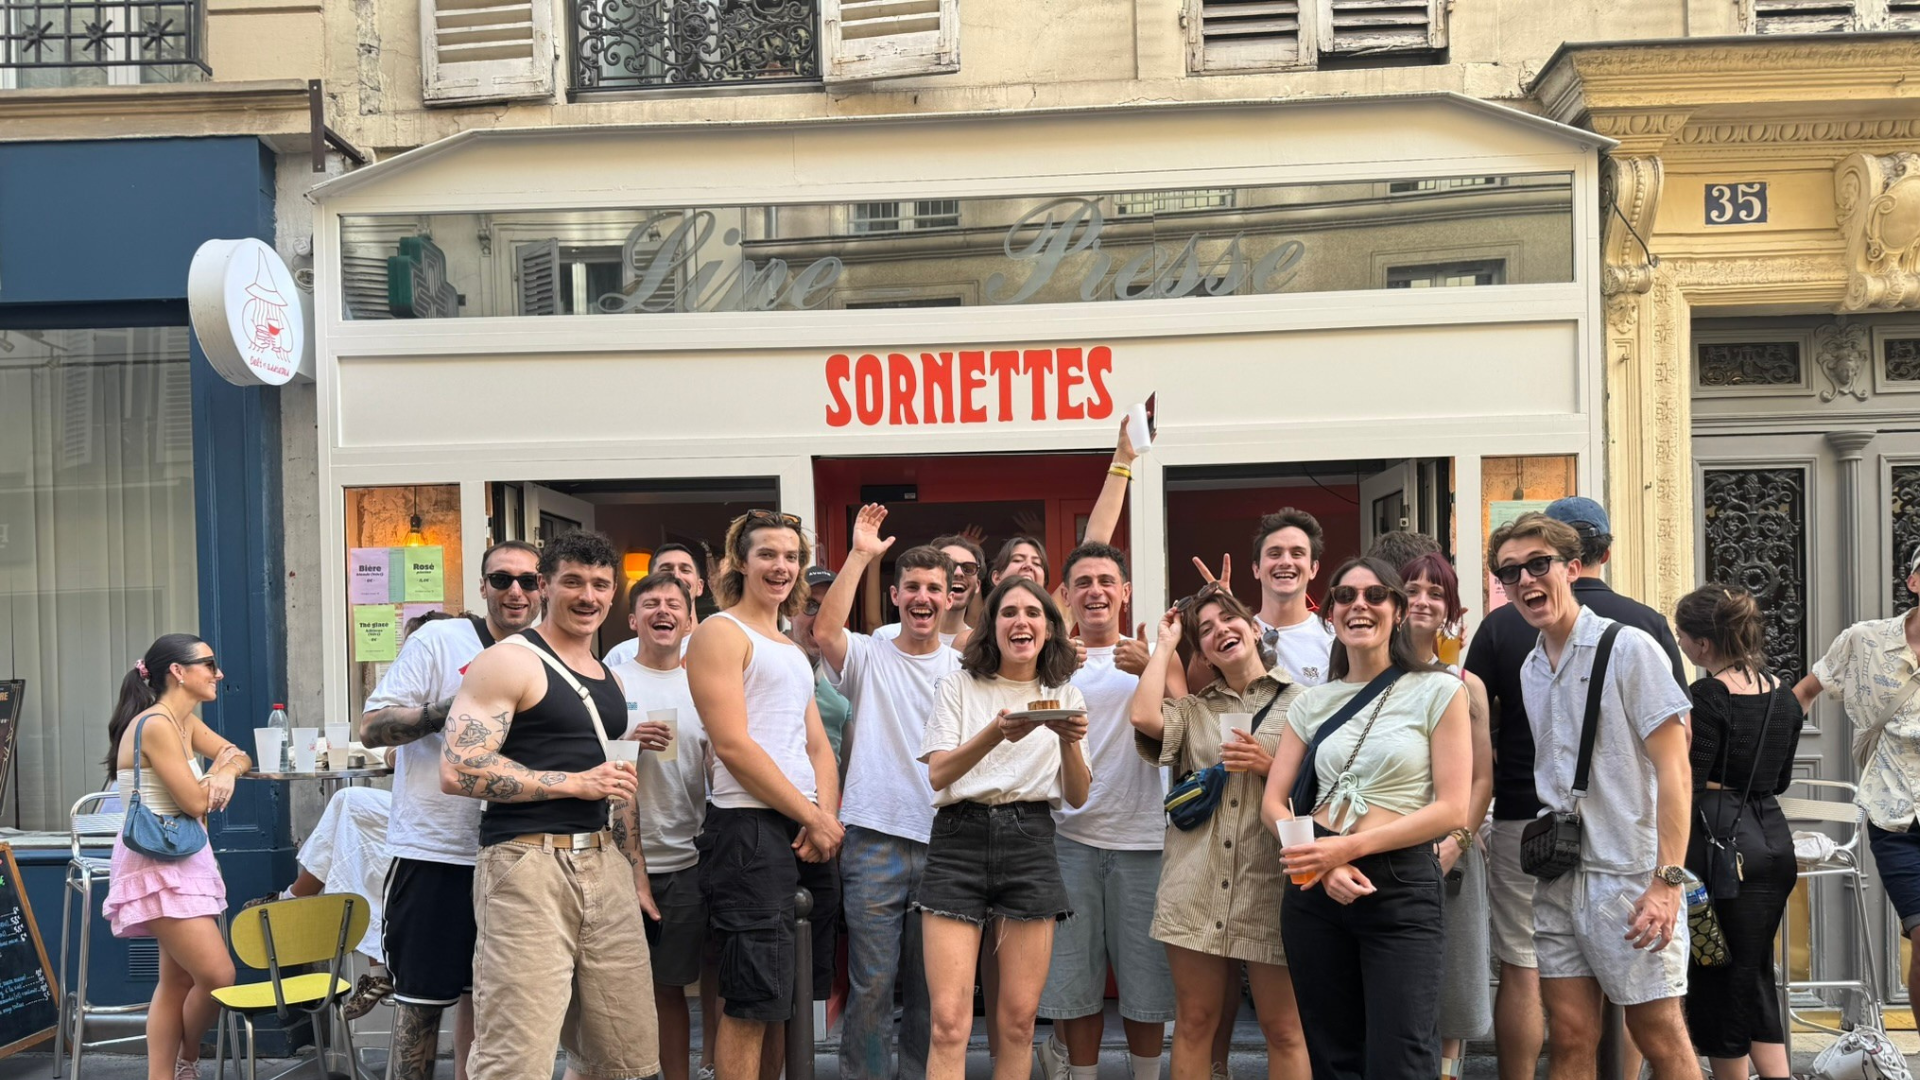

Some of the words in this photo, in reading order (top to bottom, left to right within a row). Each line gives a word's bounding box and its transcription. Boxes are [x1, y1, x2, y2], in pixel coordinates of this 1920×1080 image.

[1710, 183, 1761, 222] 35
[986, 196, 1305, 304] Presse
[825, 345, 1113, 427] SORNETTES
